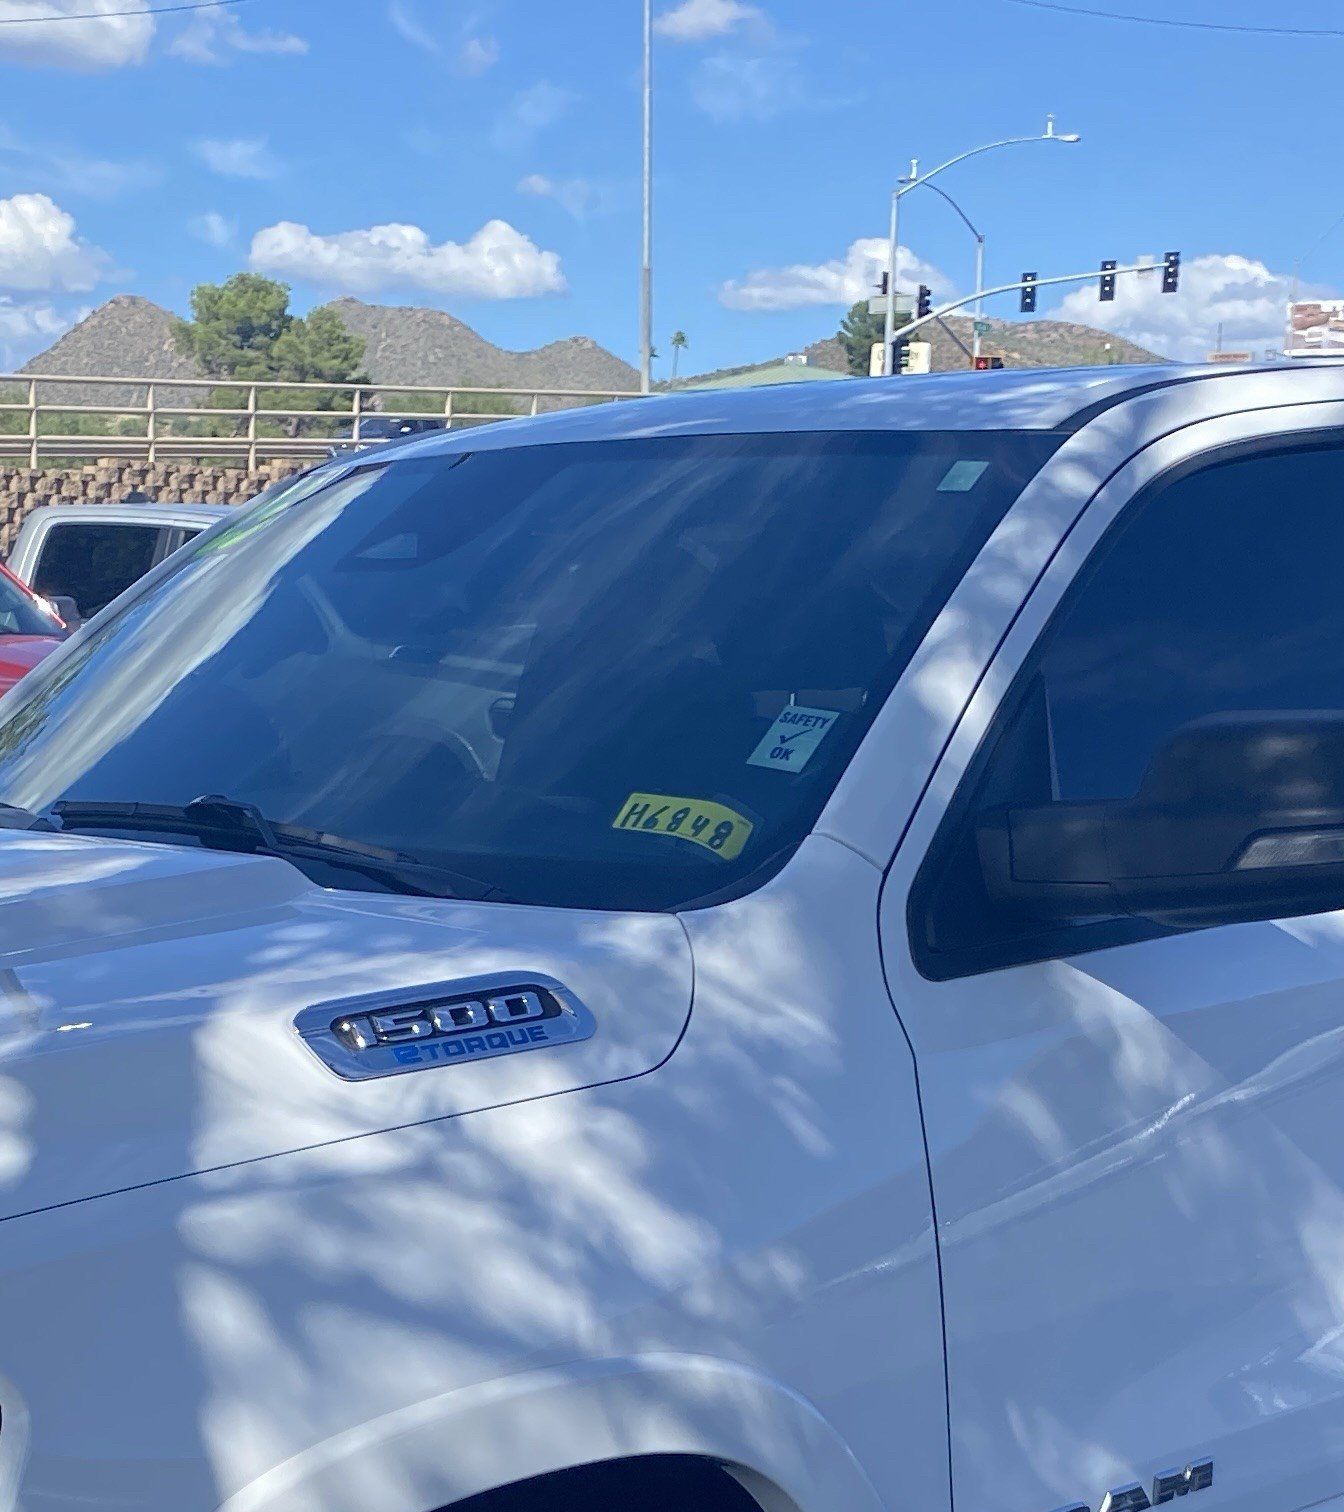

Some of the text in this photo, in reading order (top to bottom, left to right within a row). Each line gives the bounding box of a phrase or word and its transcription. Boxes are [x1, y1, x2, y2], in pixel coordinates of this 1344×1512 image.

[778, 711, 832, 729] SAFETY
[769, 746, 796, 761] OK
[619, 801, 735, 851] H6848
[350, 991, 545, 1051] 1500
